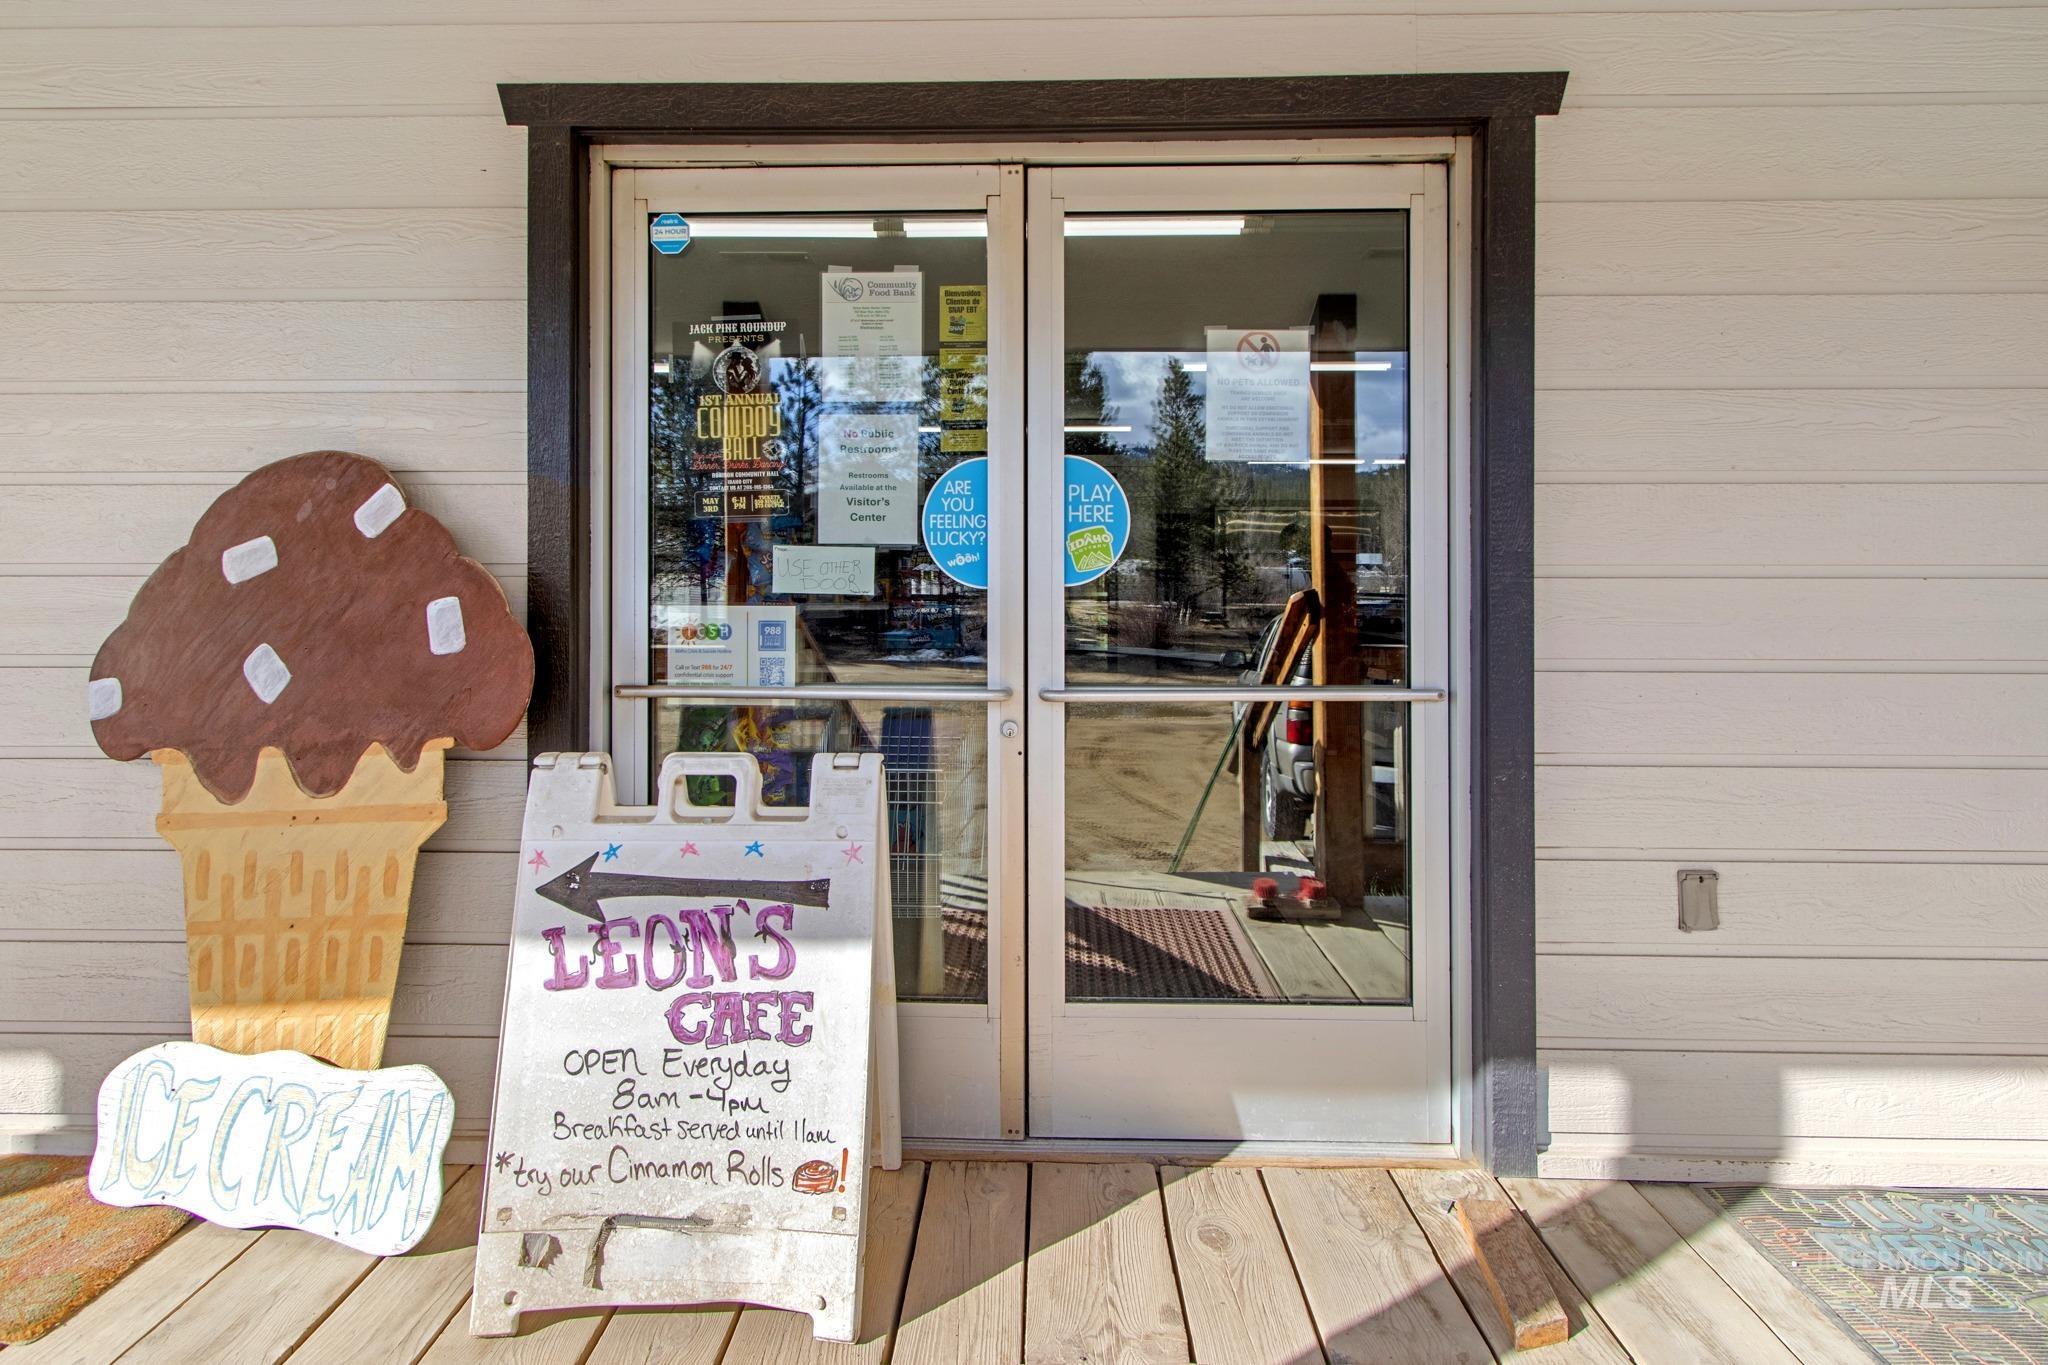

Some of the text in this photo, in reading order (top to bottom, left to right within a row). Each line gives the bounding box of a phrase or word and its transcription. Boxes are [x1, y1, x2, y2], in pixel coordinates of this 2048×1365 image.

[867, 280, 917, 289] Community
[689, 321, 786, 334] JACK PINE ROUNDUP
[708, 335, 764, 343] PRESENTS
[1217, 378, 1300, 386] NO PETS ALLOWED
[699, 393, 781, 406] 1ST ANNUAL
[697, 405, 781, 438] COWBOY
[843, 429, 894, 438] No Public
[723, 437, 761, 460] BALL
[840, 445, 898, 454] Restrooms
[944, 480, 972, 495] ARE
[1068, 484, 1114, 502] PLAY
[702, 497, 719, 505] MAY
[846, 497, 890, 507] Visitor's
[941, 497, 974, 512] YOU
[850, 513, 886, 522] Center
[1068, 504, 1115, 523] HERE
[930, 514, 987, 529] FEELING
[930, 531, 986, 546] LUCKY?
[778, 557, 815, 577] USE
[819, 560, 862, 576] OTHER
[800, 573, 861, 592] DOOR
[764, 626, 781, 635] 988
[541, 899, 798, 992] LEON'S
[665, 991, 814, 1049] CAFE
[563, 1048, 792, 1093] OPEN Everyday
[612, 1078, 680, 1110] 8am
[553, 1111, 837, 1144] Breakfast served until 11am
[100, 1059, 446, 1242] ICE CREAM
[560, 1164, 603, 1185] our
[608, 1145, 719, 1186] Cinnamon
[727, 1149, 785, 1188] Rolls
[1838, 1199, 2026, 1235] LUCK
